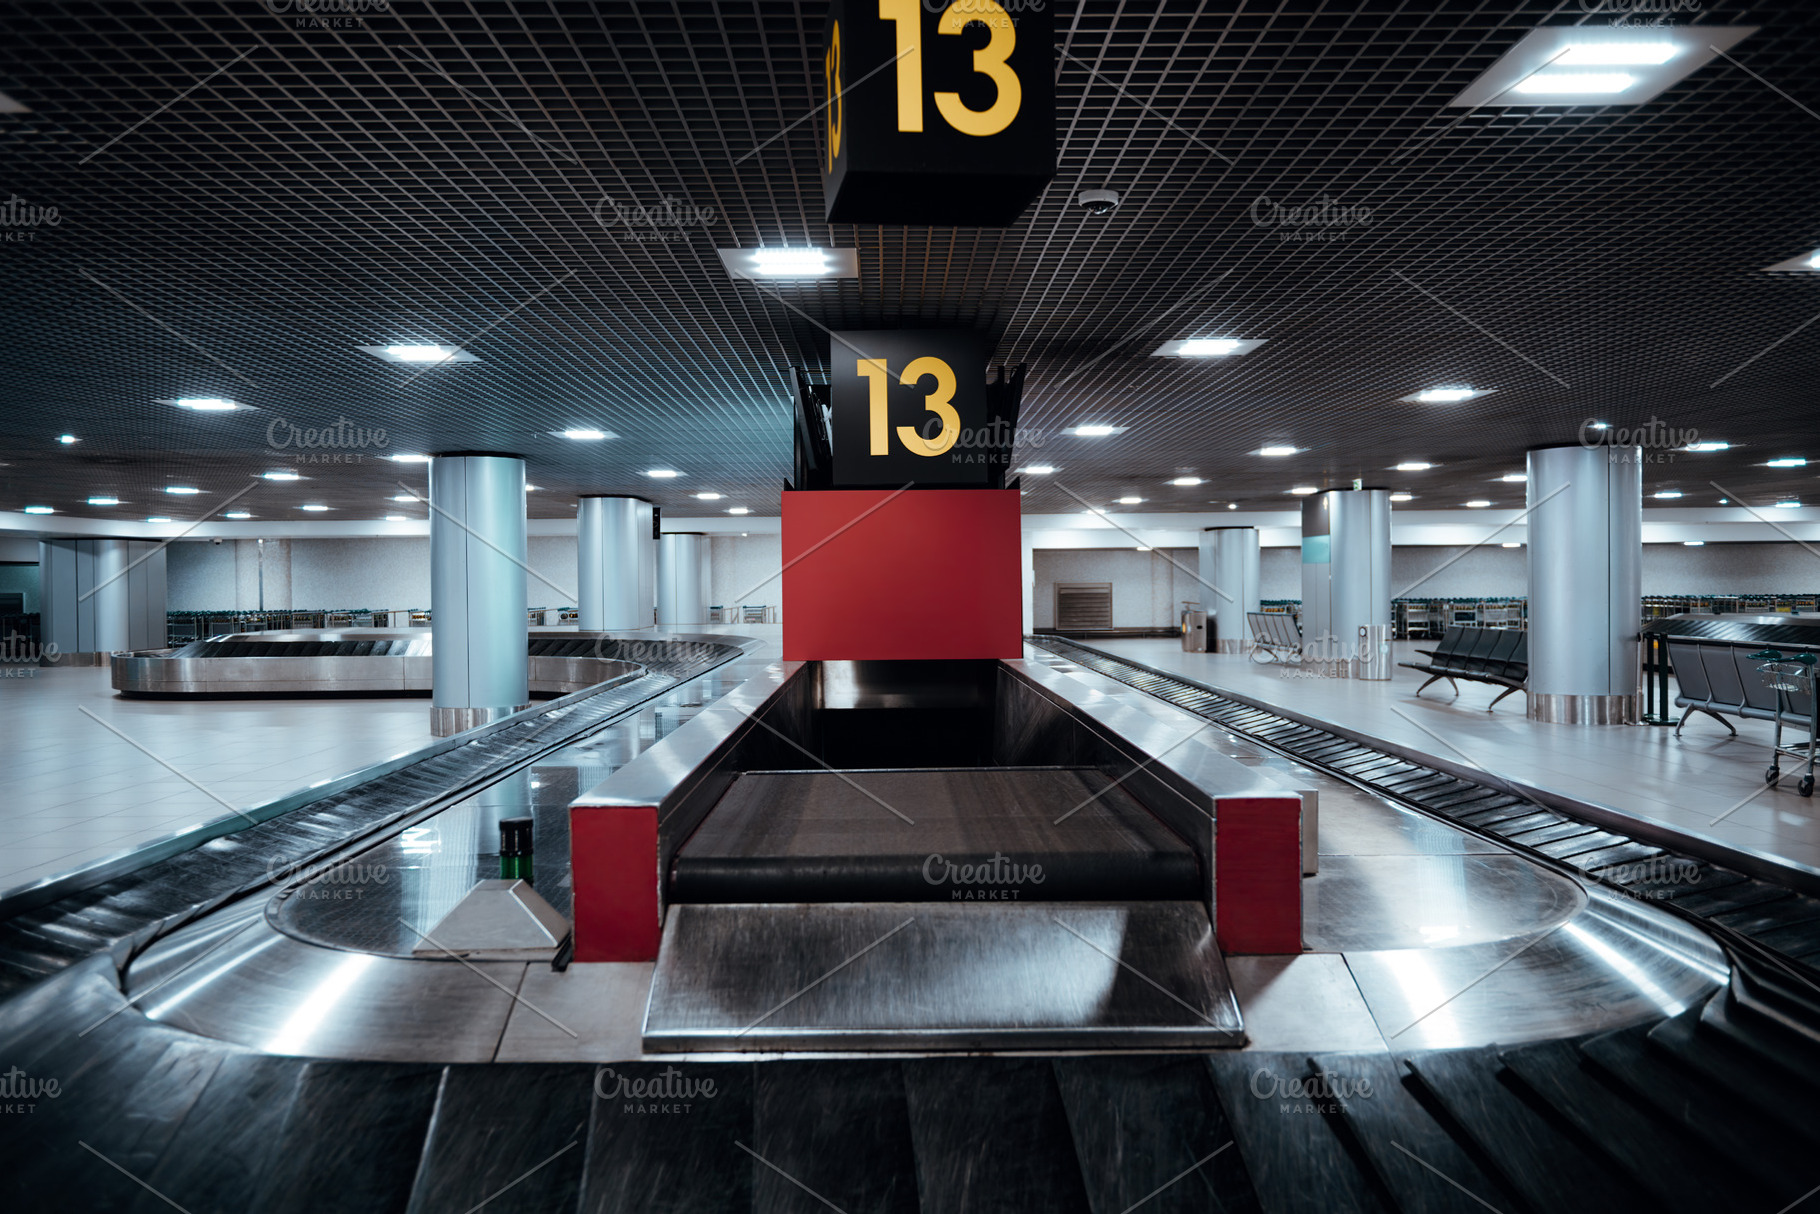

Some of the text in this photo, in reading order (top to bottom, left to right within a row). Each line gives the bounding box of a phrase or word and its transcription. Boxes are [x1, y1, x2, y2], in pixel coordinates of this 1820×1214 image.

[826, 19, 842, 175] 13
[879, 0, 1021, 137] 13
[857, 356, 961, 457] 13
